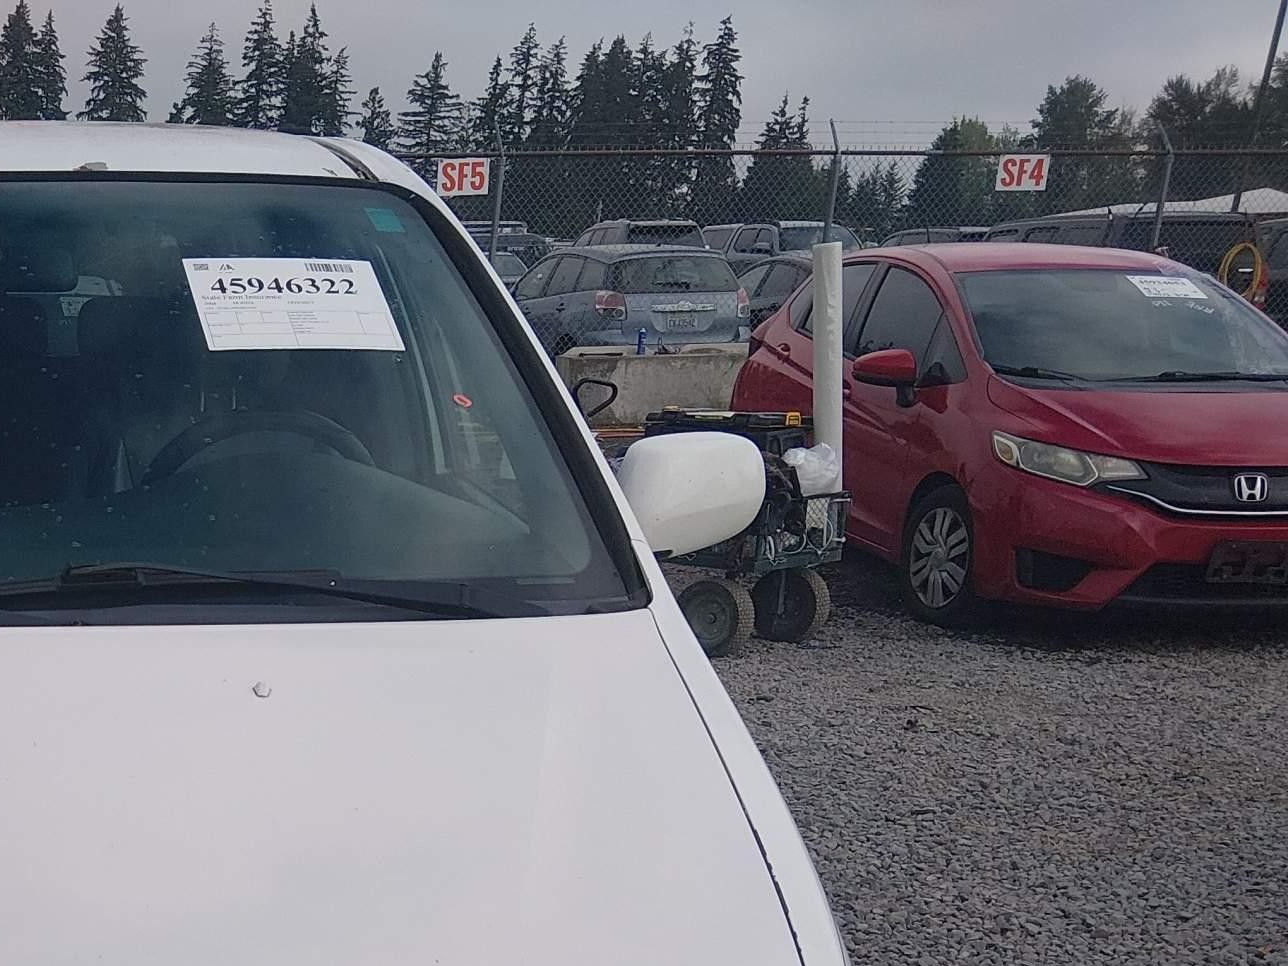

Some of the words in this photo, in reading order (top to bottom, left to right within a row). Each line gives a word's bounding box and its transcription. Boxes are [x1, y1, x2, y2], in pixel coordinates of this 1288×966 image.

[441, 161, 485, 192] SF5
[1000, 158, 1045, 187] SF4
[210, 277, 356, 295] 45946322
